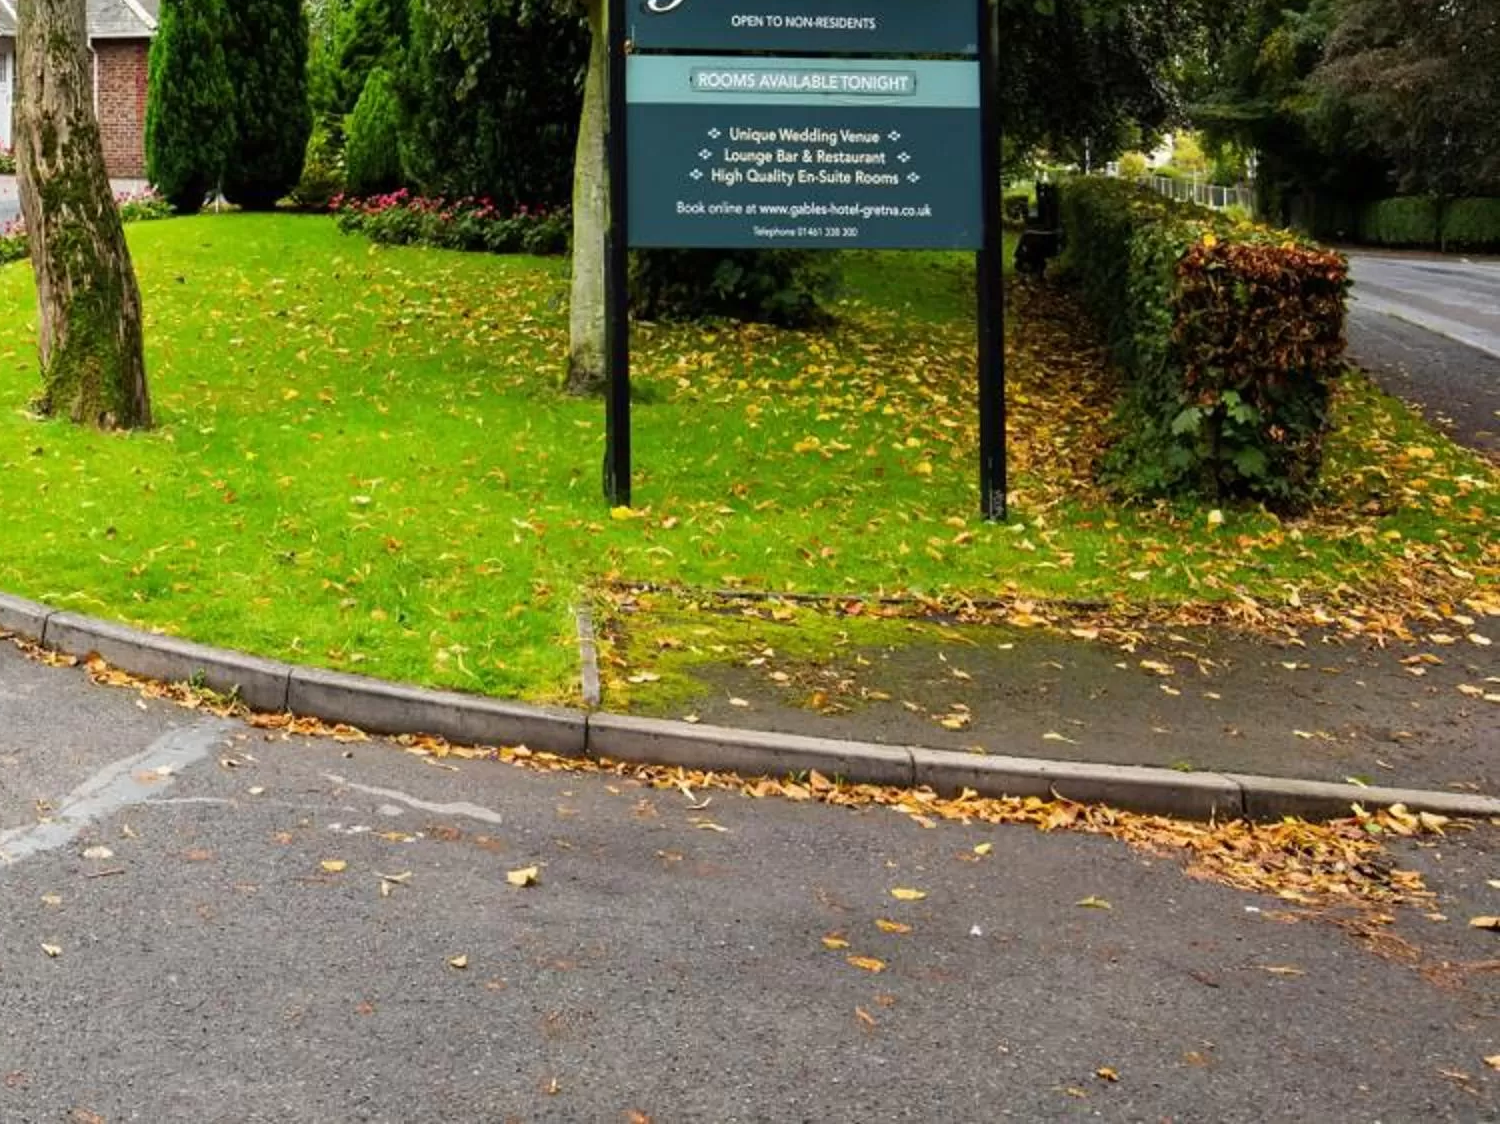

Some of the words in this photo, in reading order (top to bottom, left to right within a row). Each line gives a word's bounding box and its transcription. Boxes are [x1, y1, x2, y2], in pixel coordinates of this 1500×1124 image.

[731, 15, 764, 28] OPEN
[766, 16, 783, 28] TO
[785, 16, 877, 30] NON-RESIDENTS
[698, 73, 756, 89] ROOMS
[759, 74, 839, 90] AVAILABLE
[839, 74, 910, 91] TONIGHT
[729, 127, 777, 144] Unique
[779, 128, 837, 146] Wedding
[840, 129, 880, 143] Venue
[724, 148, 771, 166] Lounge
[776, 149, 799, 163] Bar
[801, 150, 813, 163] &
[817, 150, 886, 165] Restaurant
[711, 168, 743, 185] High
[746, 168, 795, 186] Quality
[798, 169, 851, 184] En-Suite
[855, 171, 899, 186] Rooms
[676, 201, 705, 214] Book
[708, 202, 743, 215] online
[745, 203, 757, 215] at
[759, 202, 933, 218] www.gables-hotel-gretna.co.uk
[753, 226, 795, 239] Telephone
